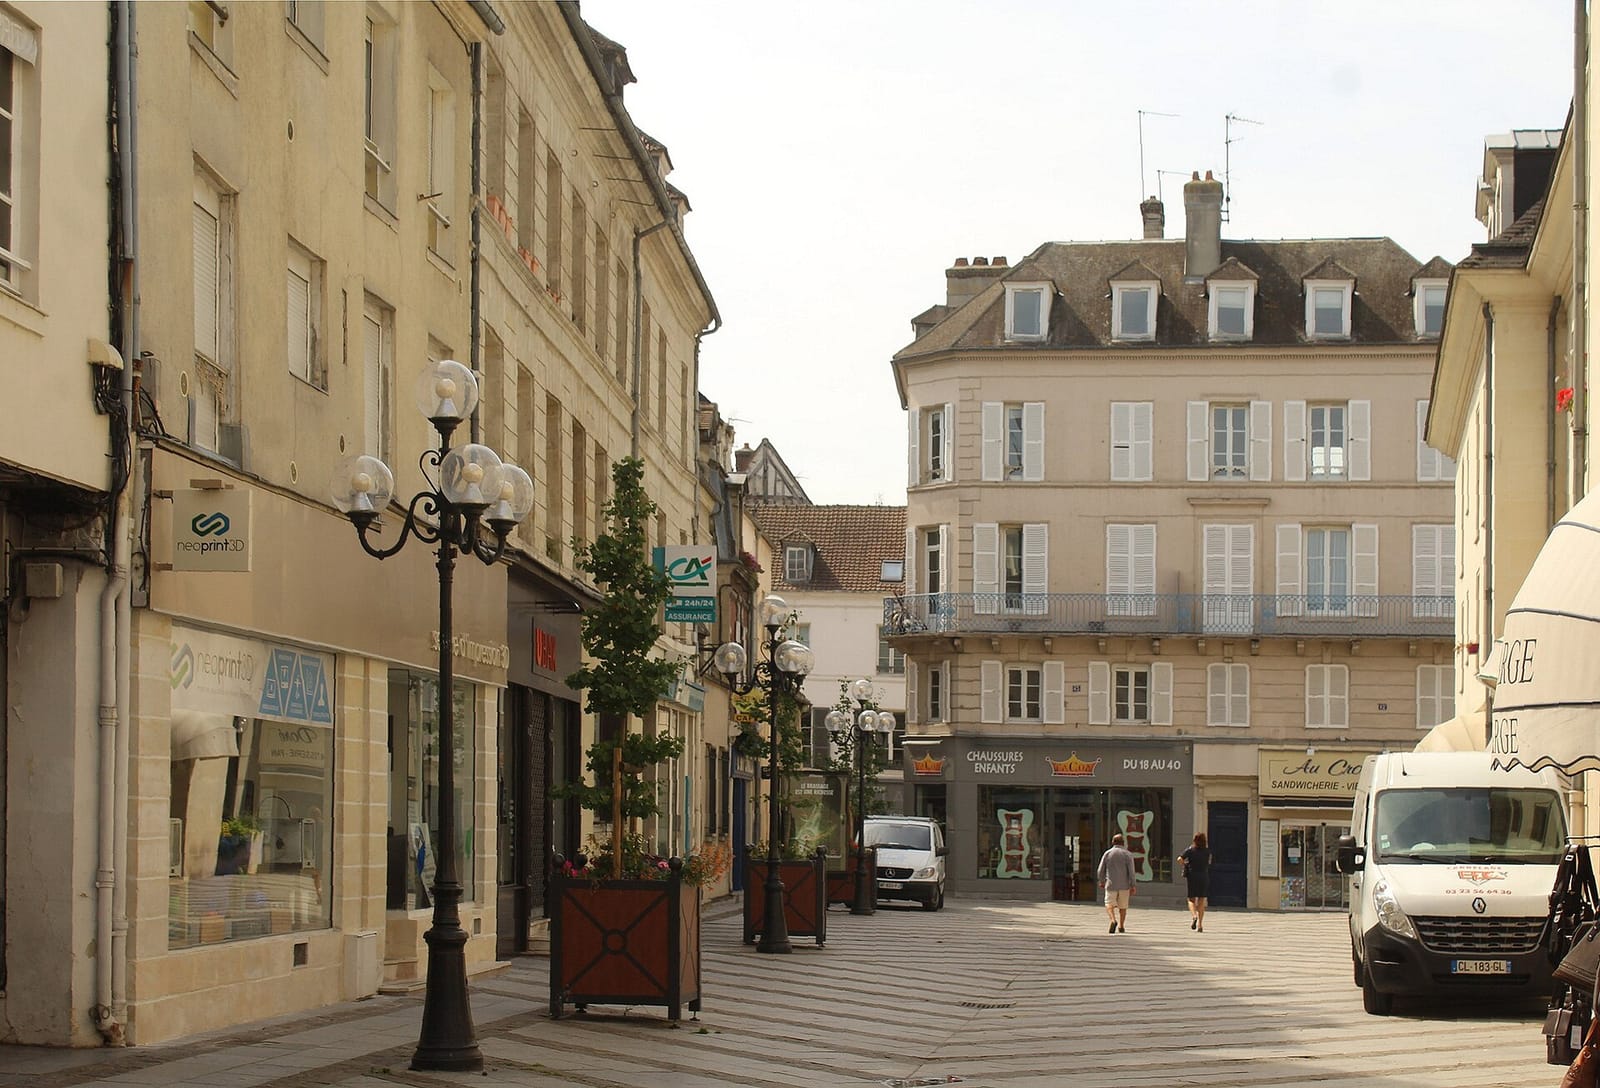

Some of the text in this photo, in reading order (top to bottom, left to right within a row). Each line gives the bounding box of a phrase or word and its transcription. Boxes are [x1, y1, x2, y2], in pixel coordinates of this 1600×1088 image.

[177, 539, 245, 555] neoprint3D
[668, 613, 712, 621] ASSURANCE
[966, 751, 1024, 762] CHAUSSURES
[974, 763, 1016, 774] ENFANTS
[1123, 759, 1182, 770] DU 18 AU 40
[1283, 758, 1321, 775] Au
[1271, 780, 1339, 791] SANDWICHERIE
[1458, 961, 1505, 973] CL-183-GL
